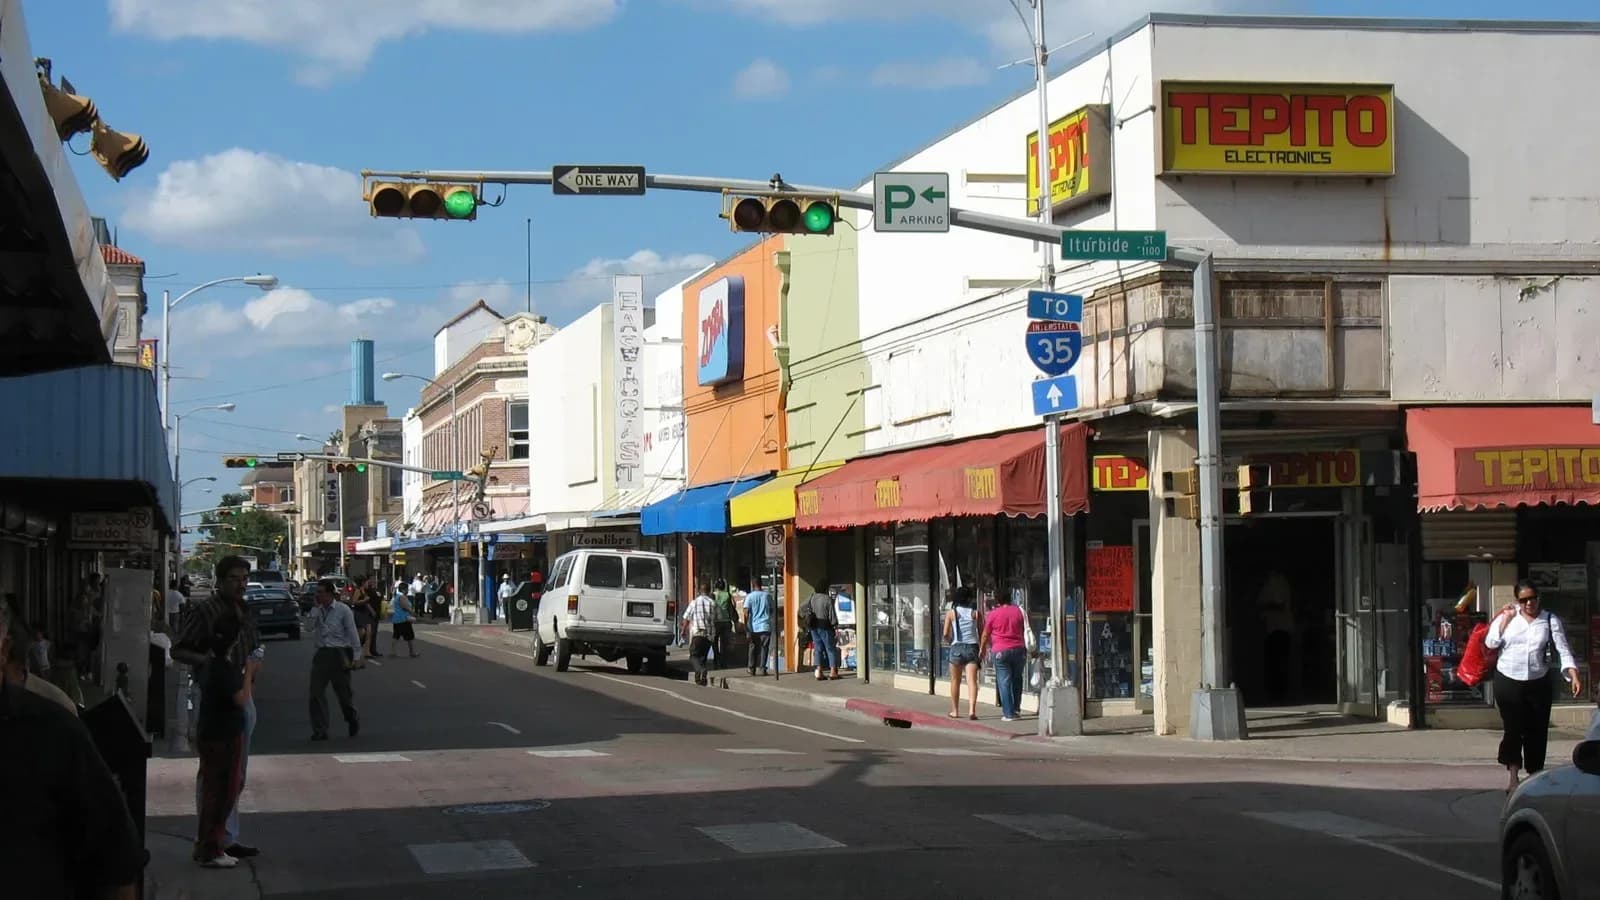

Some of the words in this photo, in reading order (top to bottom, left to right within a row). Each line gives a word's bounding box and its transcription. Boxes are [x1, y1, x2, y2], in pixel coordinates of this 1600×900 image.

[1169, 93, 1388, 147] TEPITO
[1224, 150, 1332, 165] ELECTRONICS
[575, 174, 603, 187] ONE
[607, 174, 635, 187] WAY
[1069, 237, 1129, 253] Iturbide
[1143, 236, 1154, 245] ST
[1042, 297, 1069, 316] TO
[1032, 322, 1073, 332] INTERSTATE
[1037, 337, 1073, 366] 35
[1474, 448, 1600, 487] TEPITO
[965, 467, 996, 499] TEPITO
[576, 533, 633, 545] Zonalibre
